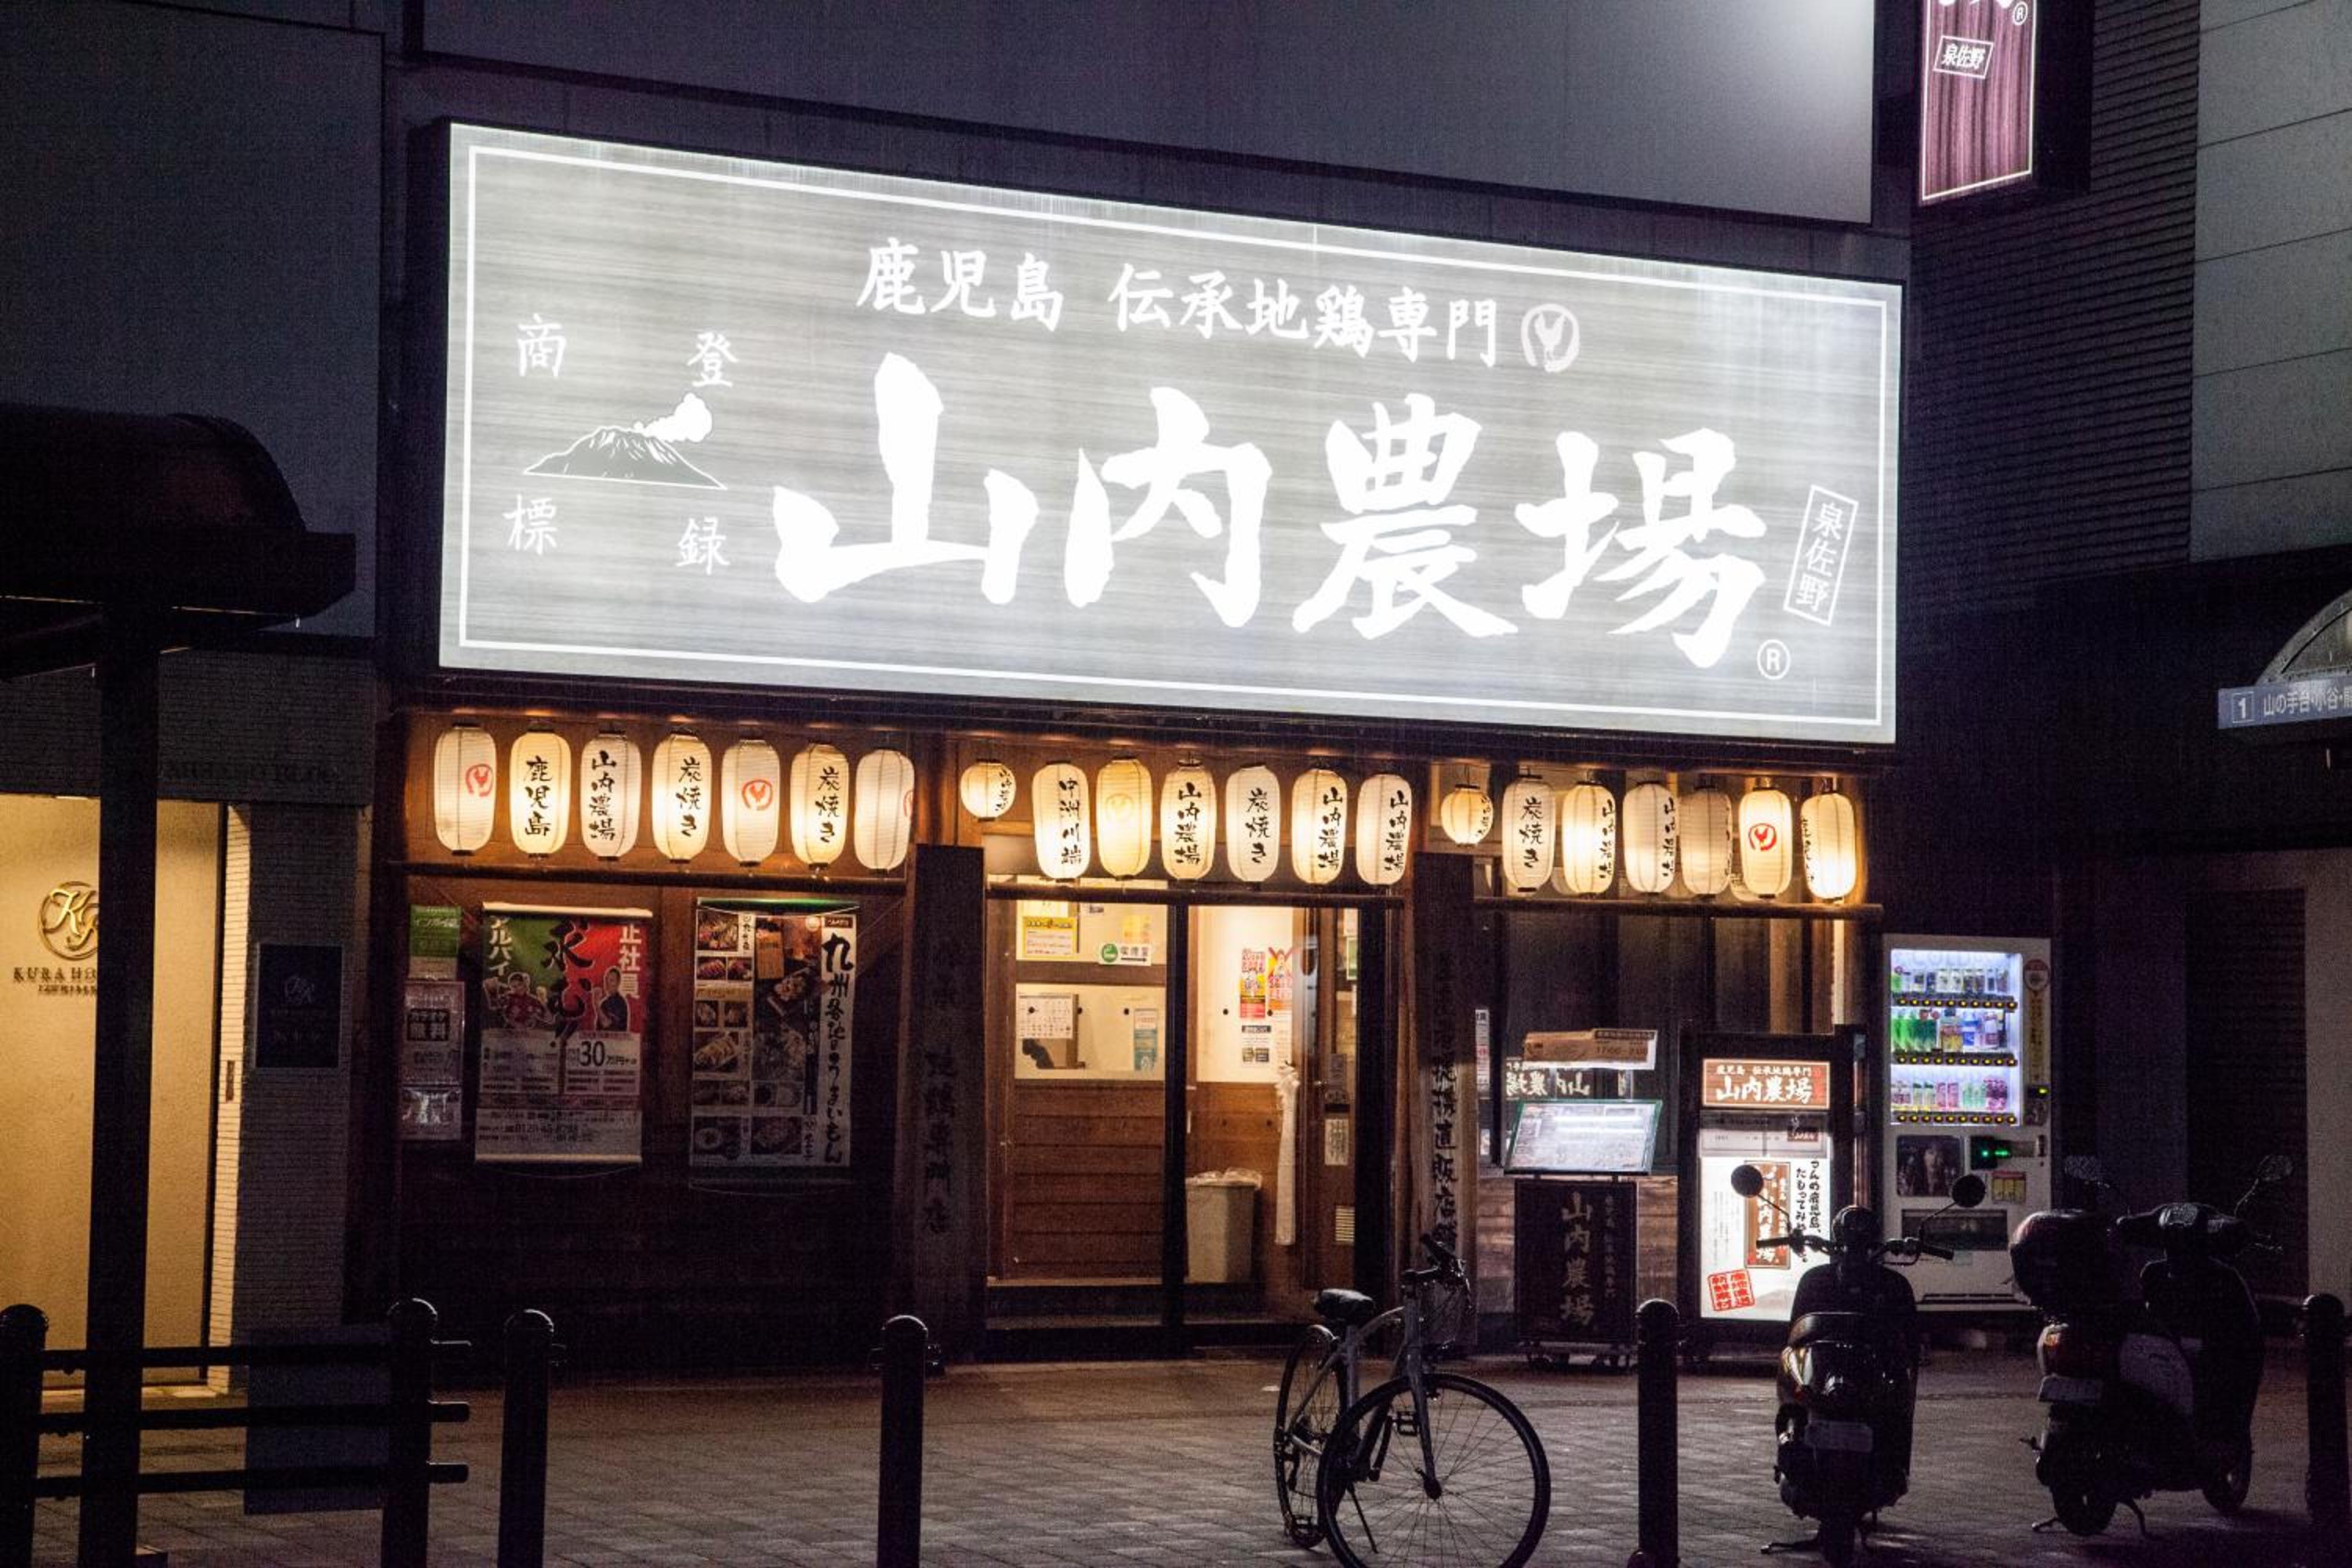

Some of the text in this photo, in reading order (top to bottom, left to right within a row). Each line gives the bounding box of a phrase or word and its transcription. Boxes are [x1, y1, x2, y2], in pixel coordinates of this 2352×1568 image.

[1941, 44, 1985, 69] 泉佐野
[856, 238, 1497, 368] 鹿児島 伝承地鶏専門
[773, 351, 1766, 668] 山内農場
[1795, 501, 1844, 614] 泉佐野
[2238, 697, 2246, 719] 1
[524, 756, 553, 837] 鹿児島
[590, 750, 616, 841] 山内農場
[677, 757, 701, 837] 炭焼き
[815, 767, 840, 843] 炭焼き
[1174, 782, 1201, 866] 山内農場
[1246, 789, 1270, 863] 炭焼き
[1318, 787, 1342, 870] 山内農場
[1385, 790, 1409, 873] 山内農場
[1519, 797, 1543, 868] 炭焼き
[13, 967, 64, 982] KURA
[1715, 1075, 1813, 1104] 山内農場
[1559, 1191, 1595, 1326] 山内農場
